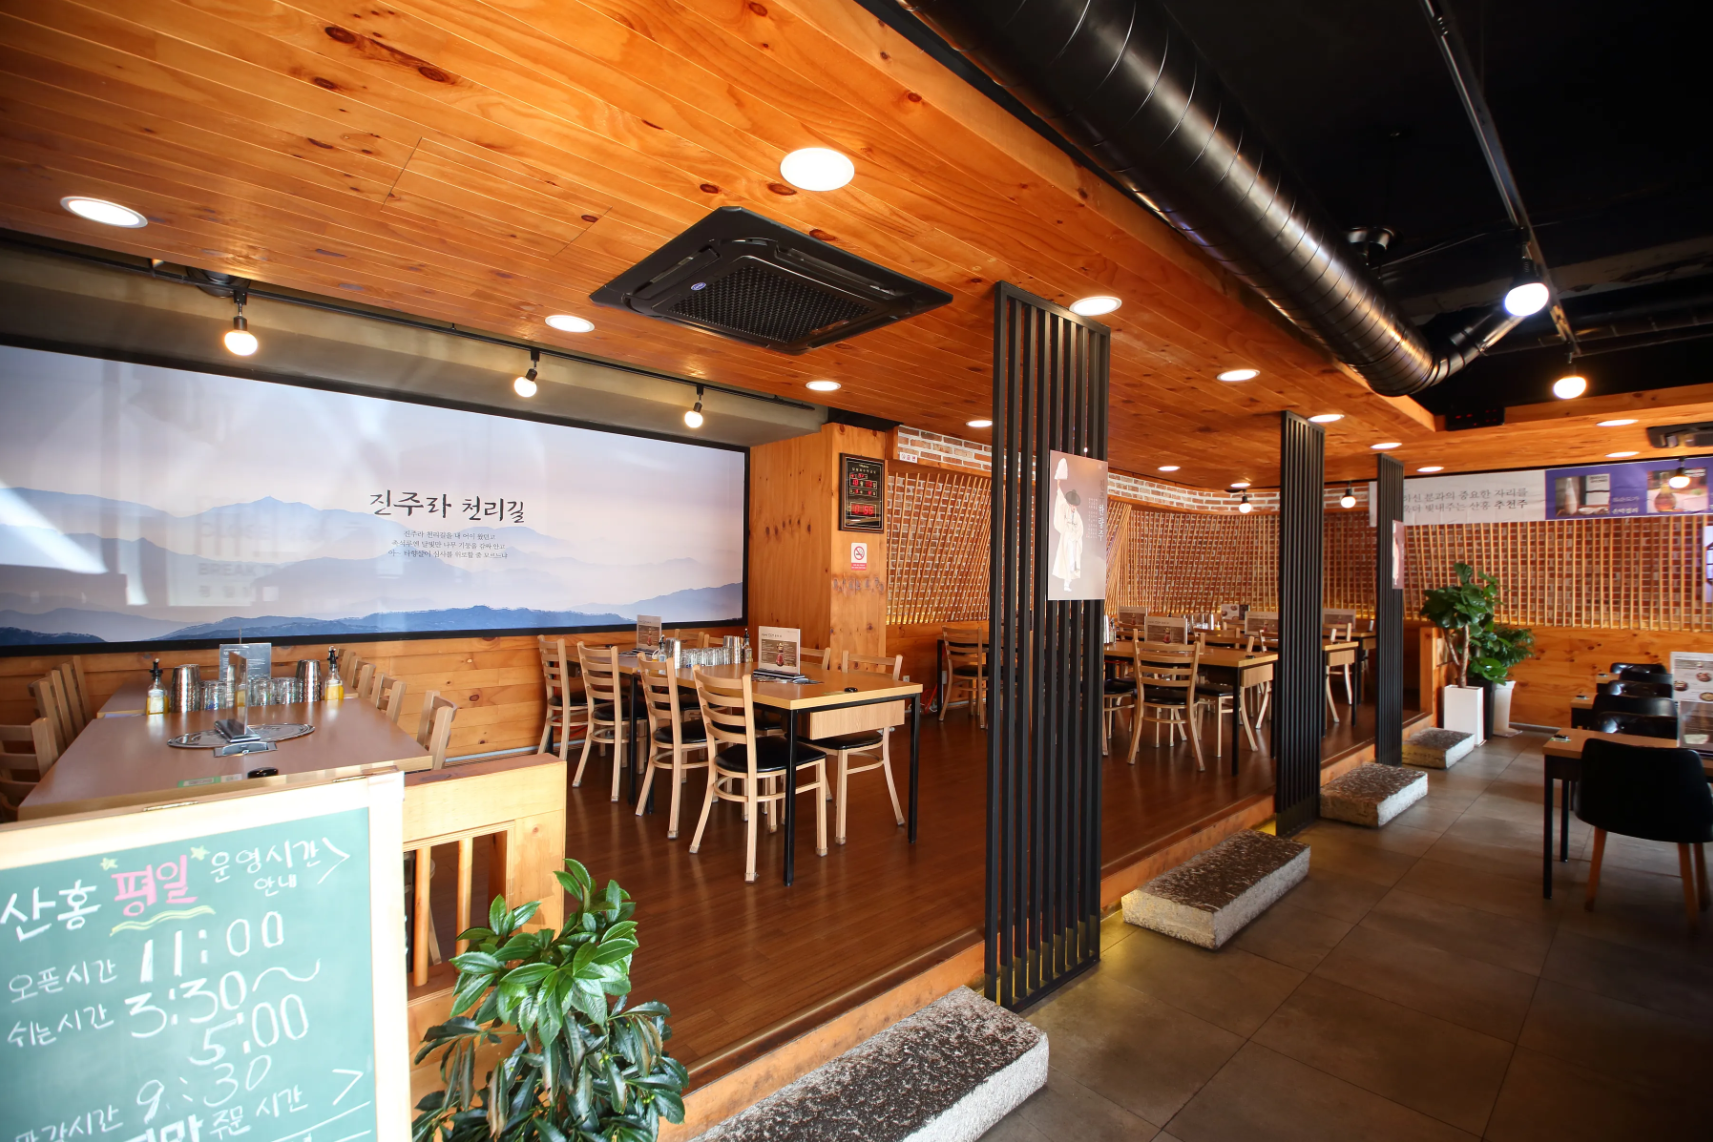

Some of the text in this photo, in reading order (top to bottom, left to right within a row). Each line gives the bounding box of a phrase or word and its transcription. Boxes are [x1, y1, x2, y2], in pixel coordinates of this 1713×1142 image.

[370, 489, 525, 523] 진주라 천리길
[1424, 491, 1455, 502] 분과의
[1458, 489, 1490, 500] 중요한
[1494, 487, 1528, 498] 자리를
[404, 530, 424, 539] 진주라
[0, 839, 321, 942] 산홍 평일 운영시간
[254, 873, 298, 898] 안내
[8, 910, 284, 1003] 오픈시간 11:00
[7, 1004, 115, 1048] 쉬는시간
[187, 993, 310, 1066] 5:00
[137, 1054, 273, 1123] 9:30
[209, 1105, 252, 1141] 주문
[255, 1083, 309, 1118] 시간
